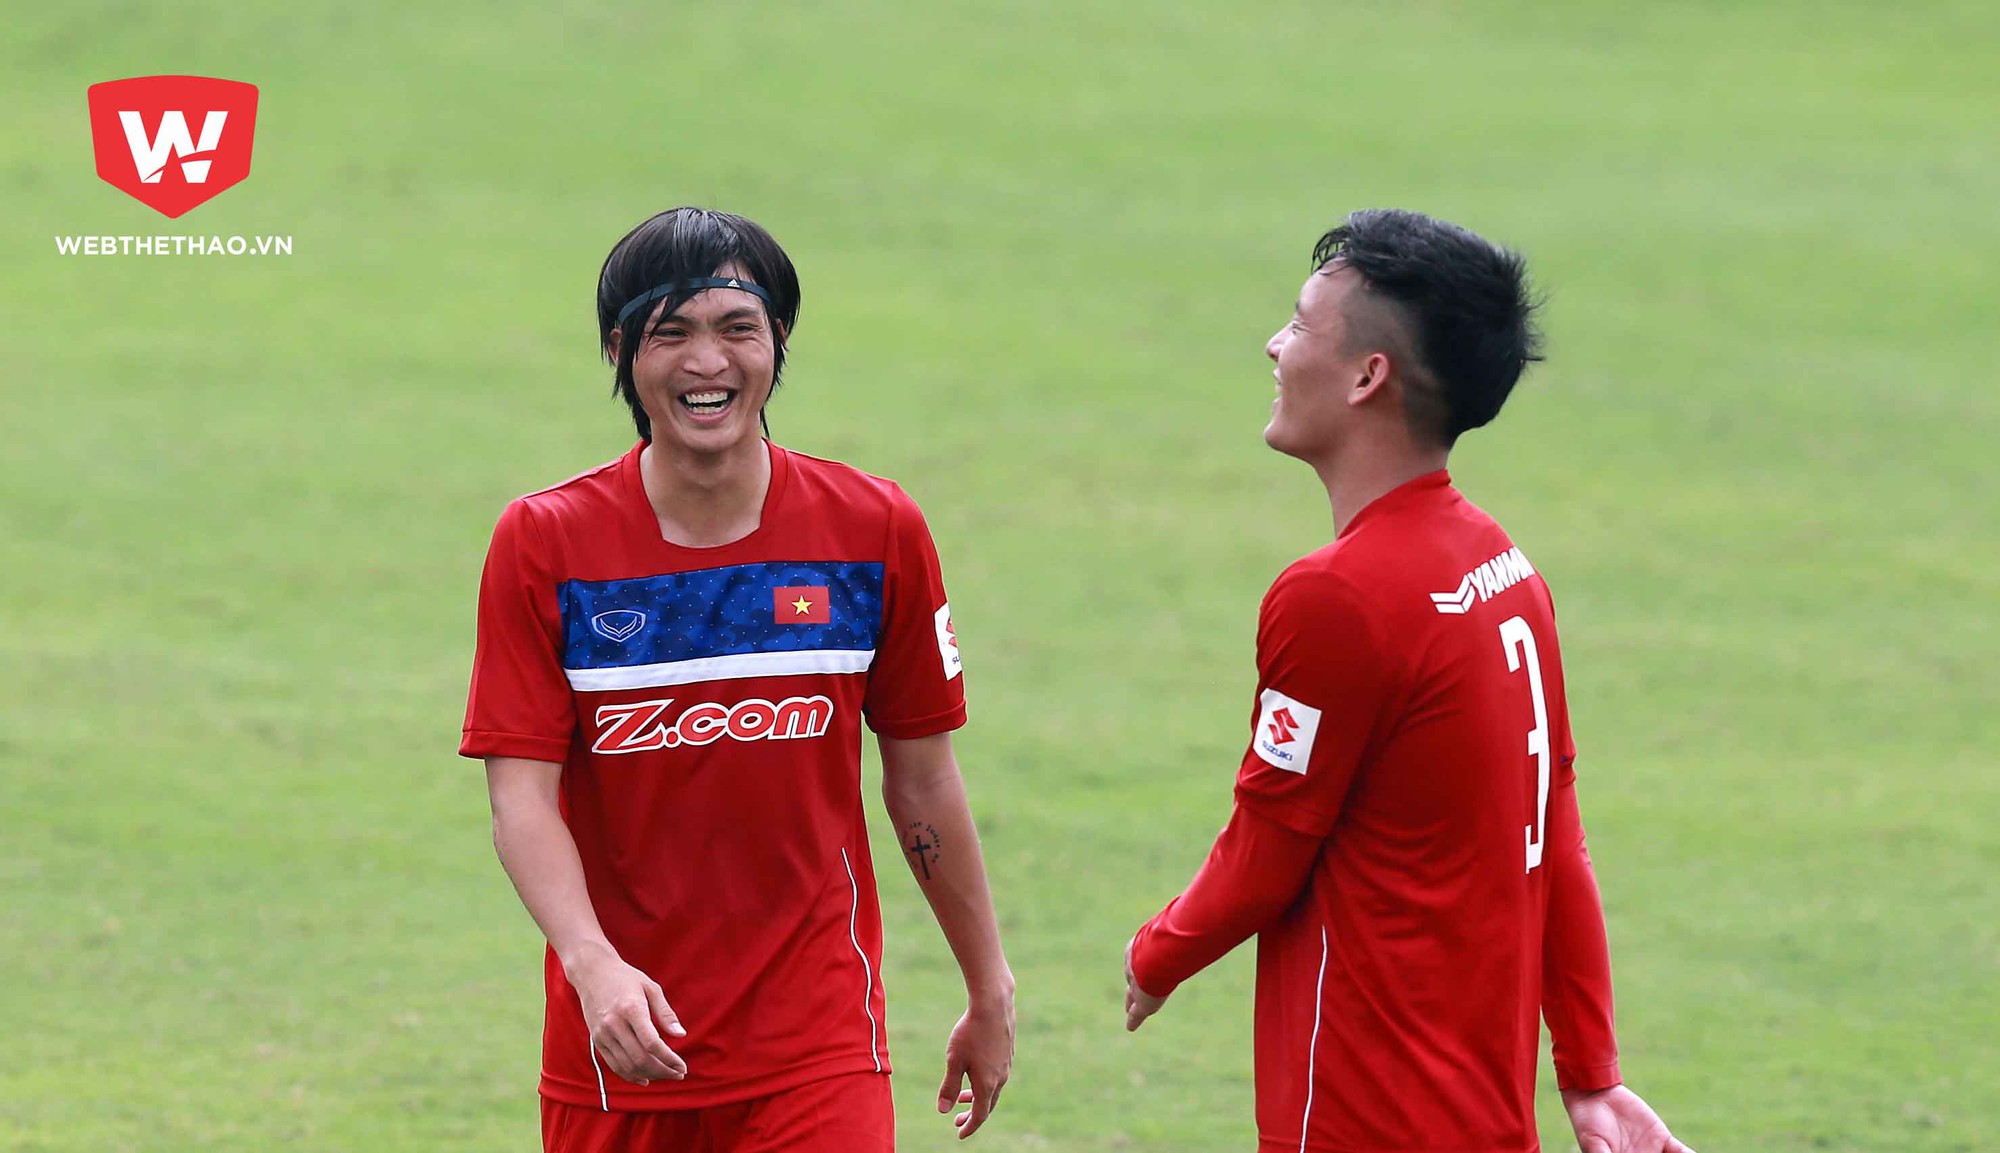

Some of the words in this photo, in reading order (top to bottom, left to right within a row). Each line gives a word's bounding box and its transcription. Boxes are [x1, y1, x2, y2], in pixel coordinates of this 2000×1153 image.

[591, 695, 834, 755] Z.com
[1262, 740, 1293, 761] SUZUKI
[1498, 615, 1550, 874] 3
